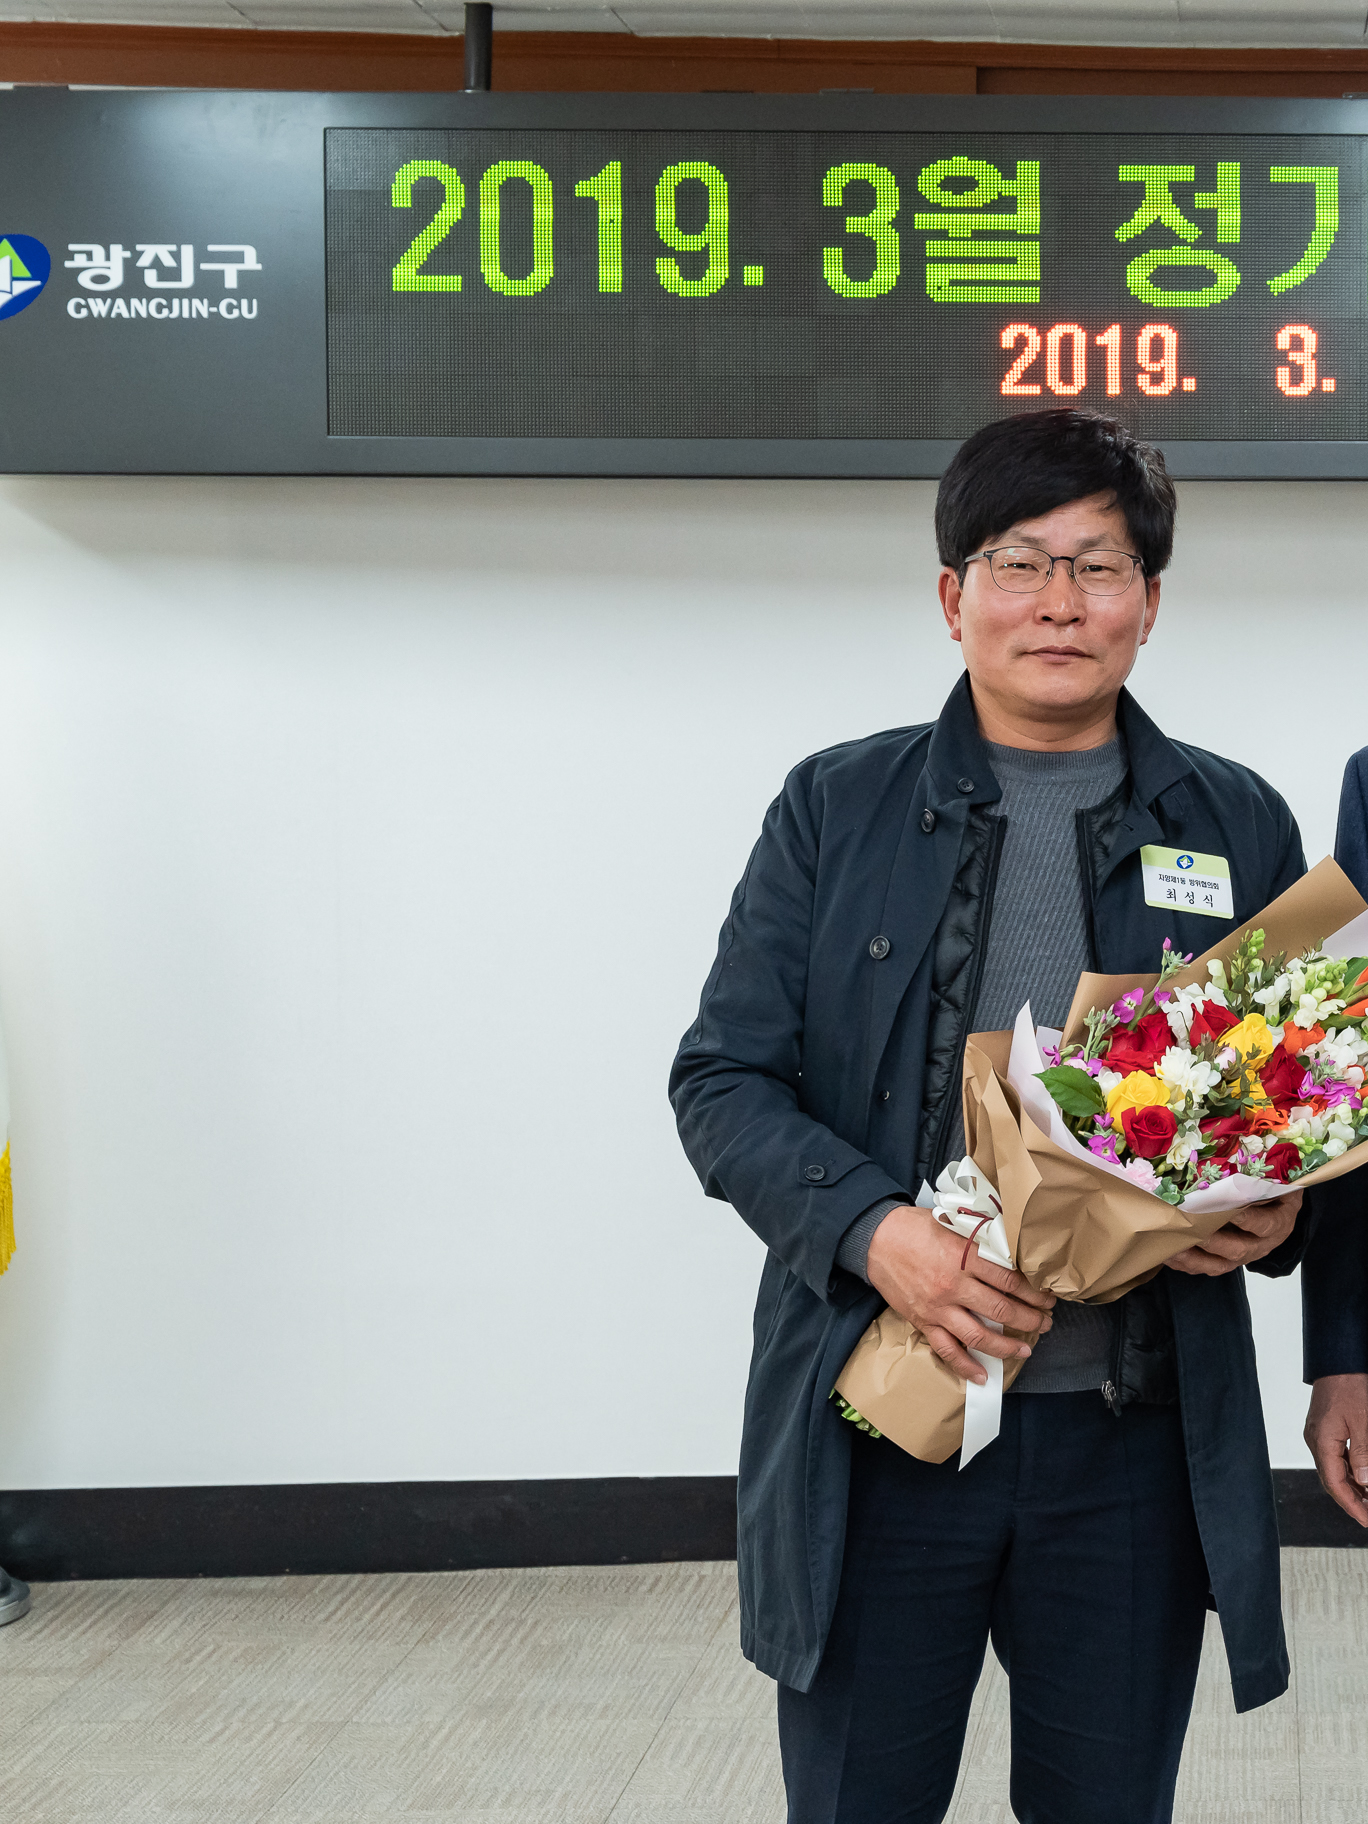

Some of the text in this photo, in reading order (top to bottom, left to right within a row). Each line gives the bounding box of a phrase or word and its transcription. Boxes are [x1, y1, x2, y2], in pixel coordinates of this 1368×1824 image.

[390, 159, 764, 298] 2019.
[822, 155, 1041, 303] 3월
[64, 243, 262, 291] 광진구
[66, 297, 258, 319] GWANGJIN-GU
[999, 322, 1197, 397] 2019.
[1275, 323, 1337, 397] 3.
